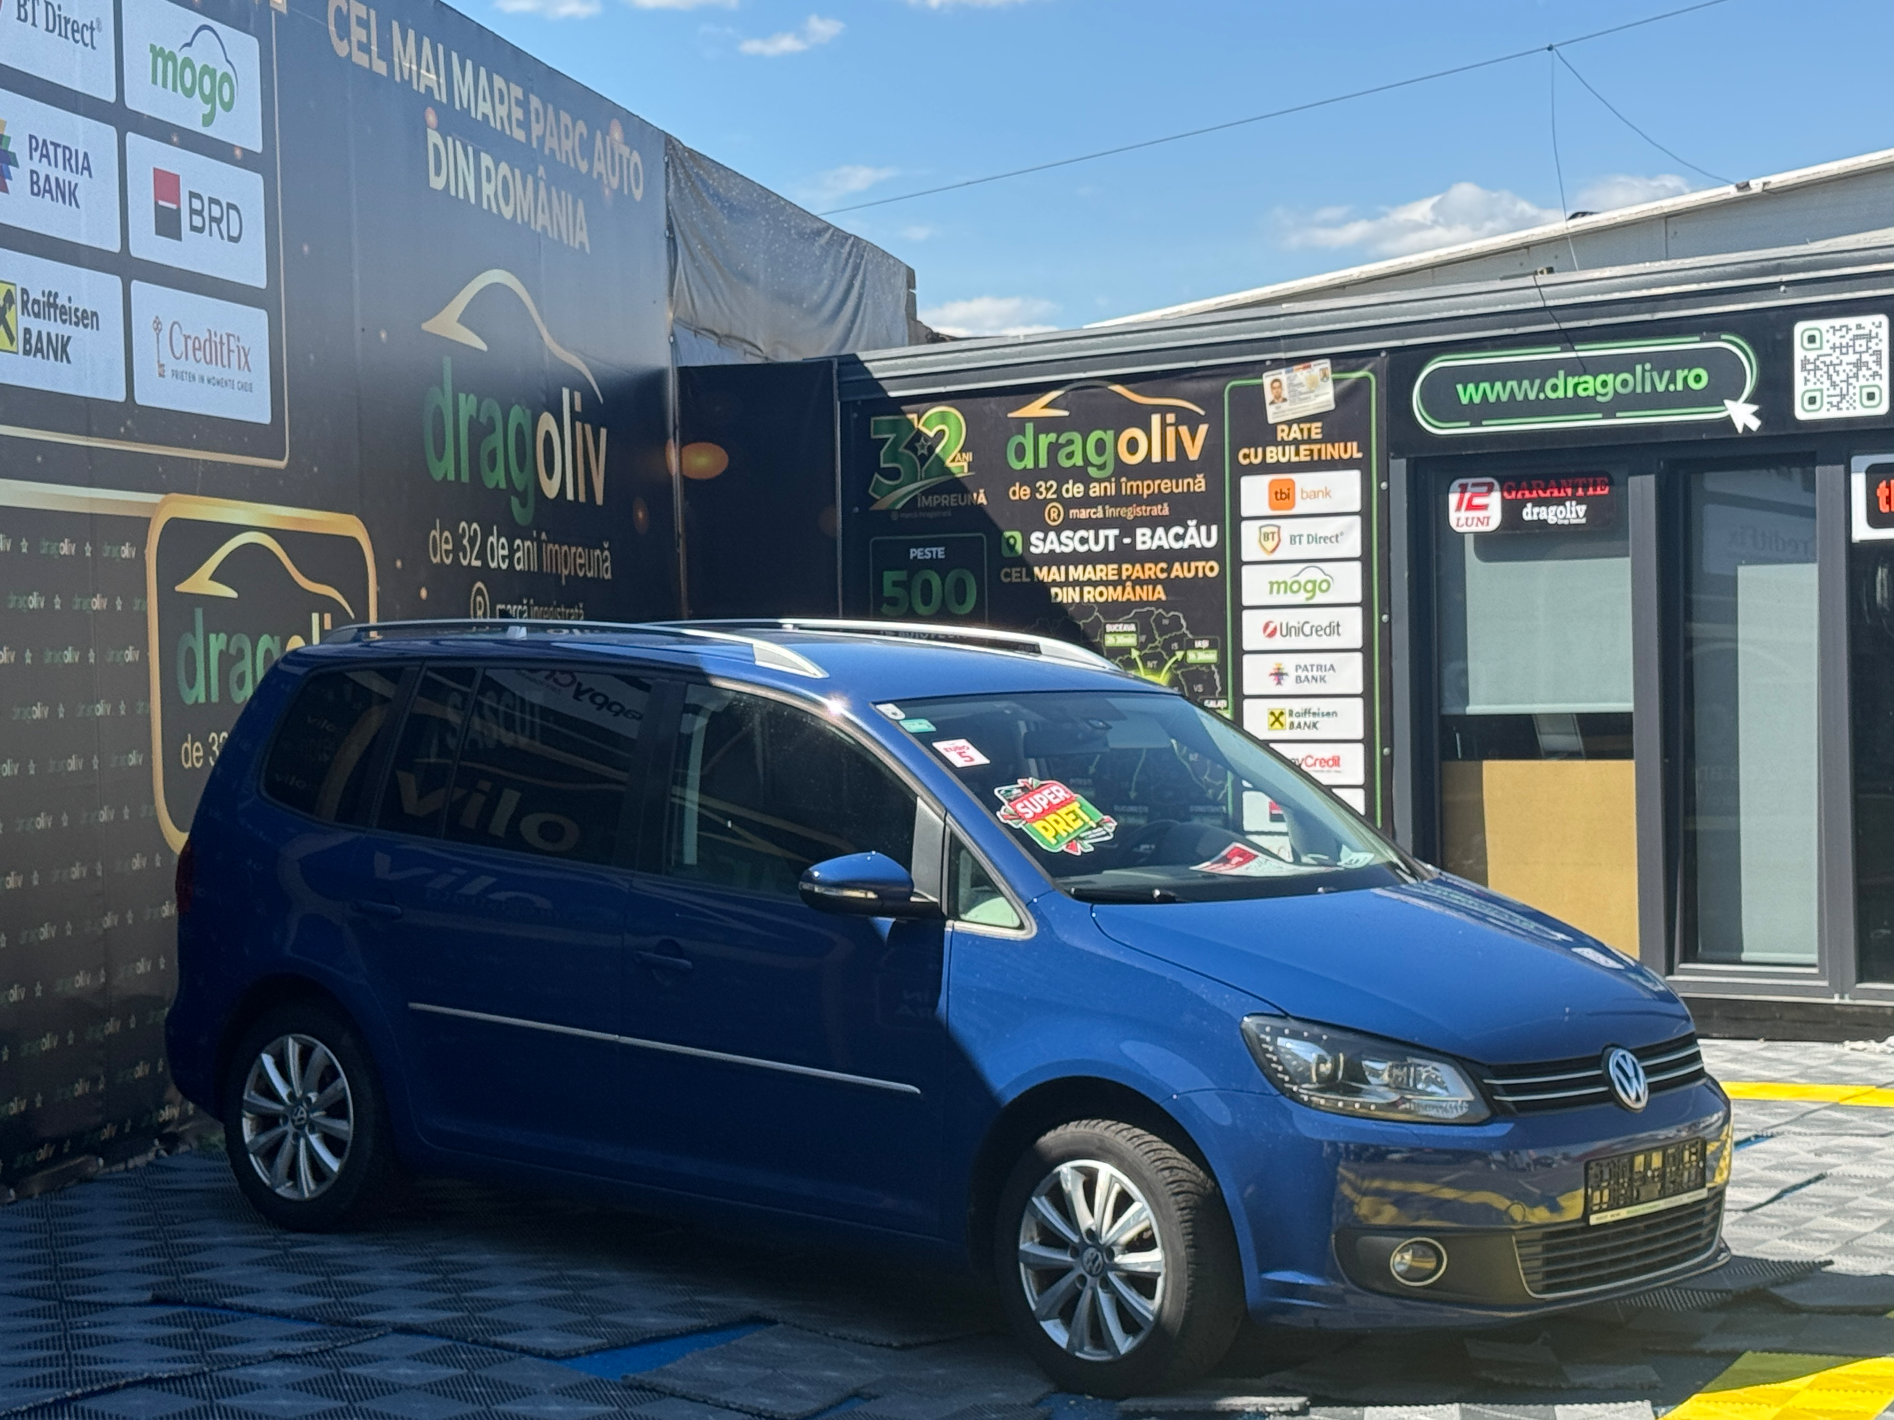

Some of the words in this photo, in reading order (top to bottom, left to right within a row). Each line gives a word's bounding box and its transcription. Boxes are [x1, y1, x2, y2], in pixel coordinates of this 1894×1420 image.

[15, 0, 40, 27] BT
[150, 43, 235, 127] mogo
[328, 0, 387, 76] CEL
[392, 20, 447, 104] MAI
[452, 51, 526, 143] MARE
[529, 93, 588, 175] PARC
[592, 130, 644, 202] AUTO
[28, 134, 93, 179] PATRIA
[30, 170, 80, 209] BANK
[427, 127, 475, 205] DIN
[481, 152, 590, 254] ROMÂNIA
[189, 190, 243, 243] BRD
[20, 288, 100, 331] Raiffeisen
[22, 331, 72, 364] BANK
[169, 320, 251, 373] CreditFix
[1455, 364, 1708, 405] www.dragoliv.ro
[423, 355, 607, 526] dragoliv
[1276, 422, 1322, 441] RATE
[955, 452, 973, 463] ANI
[1007, 413, 1209, 478] dragoliv
[1238, 448, 1262, 465] CU
[1265, 441, 1363, 463] BULETINUL
[1009, 483, 1031, 500] de
[1035, 481, 1057, 499] 32
[1062, 480, 1084, 498] de
[1089, 478, 1116, 496] ani
[1121, 474, 1206, 498] împreună
[1274, 488, 1291, 501] tbi
[1300, 487, 1332, 500] bank
[1454, 482, 1494, 512] 12
[1503, 477, 1610, 499] GARANTIE
[1876, 479, 1894, 513] t
[1069, 507, 1104, 519] marcă
[1105, 503, 1170, 520] înregistrată
[1456, 516, 1490, 528] LUNI
[1522, 501, 1587, 524] dragoliv
[1029, 529, 1119, 554] SASCUT
[1135, 520, 1218, 550] BACĂU
[1263, 532, 1276, 542] BT
[1290, 534, 1304, 545] BT
[429, 518, 453, 565] de
[458, 521, 482, 567] 32
[487, 525, 509, 570] de
[514, 532, 538, 572] ani
[542, 531, 612, 585] împreună
[910, 548, 945, 559] PESTE
[1001, 568, 1030, 582] CEL
[1034, 565, 1065, 582] MAI
[1069, 563, 1119, 580] MARE
[1121, 562, 1168, 580] PARC
[1170, 560, 1219, 578] AUTO
[880, 568, 977, 616] 500
[1052, 586, 1080, 603] DIN
[1083, 581, 1166, 603] ROMÂNIA
[1268, 578, 1331, 601] mogo
[1280, 621, 1341, 638] UniCredit
[1295, 664, 1336, 673] PATRIA
[1295, 675, 1327, 684] BANK
[1288, 708, 1338, 719] Raiffeisen
[1288, 721, 1319, 731] BANK
[181, 733, 203, 769] de
[957, 751, 974, 763] 5
[1016, 784, 1070, 819] SUPER
